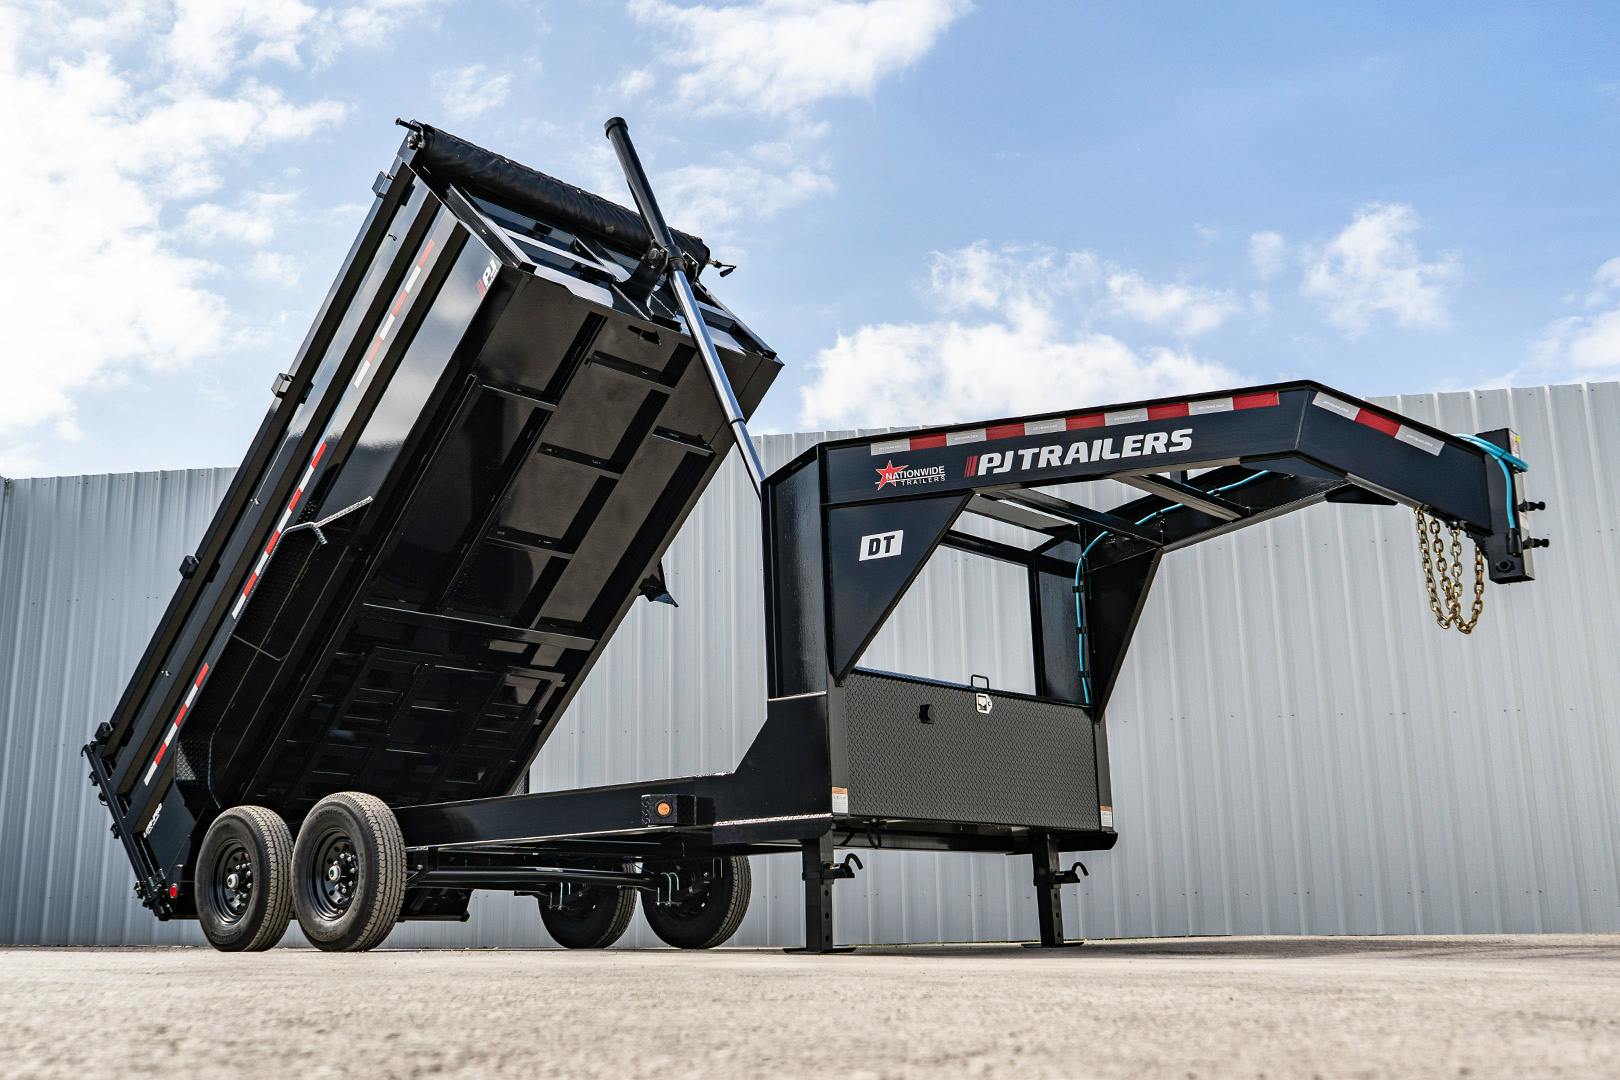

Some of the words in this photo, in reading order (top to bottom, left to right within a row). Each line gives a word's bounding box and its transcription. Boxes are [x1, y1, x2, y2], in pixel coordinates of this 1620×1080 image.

[978, 451, 1014, 476] PJ
[1018, 428, 1193, 470] TRAILERS
[886, 465, 945, 479] NATIONWIDE
[901, 475, 946, 486] TRAILERS
[868, 535, 896, 556] DT
